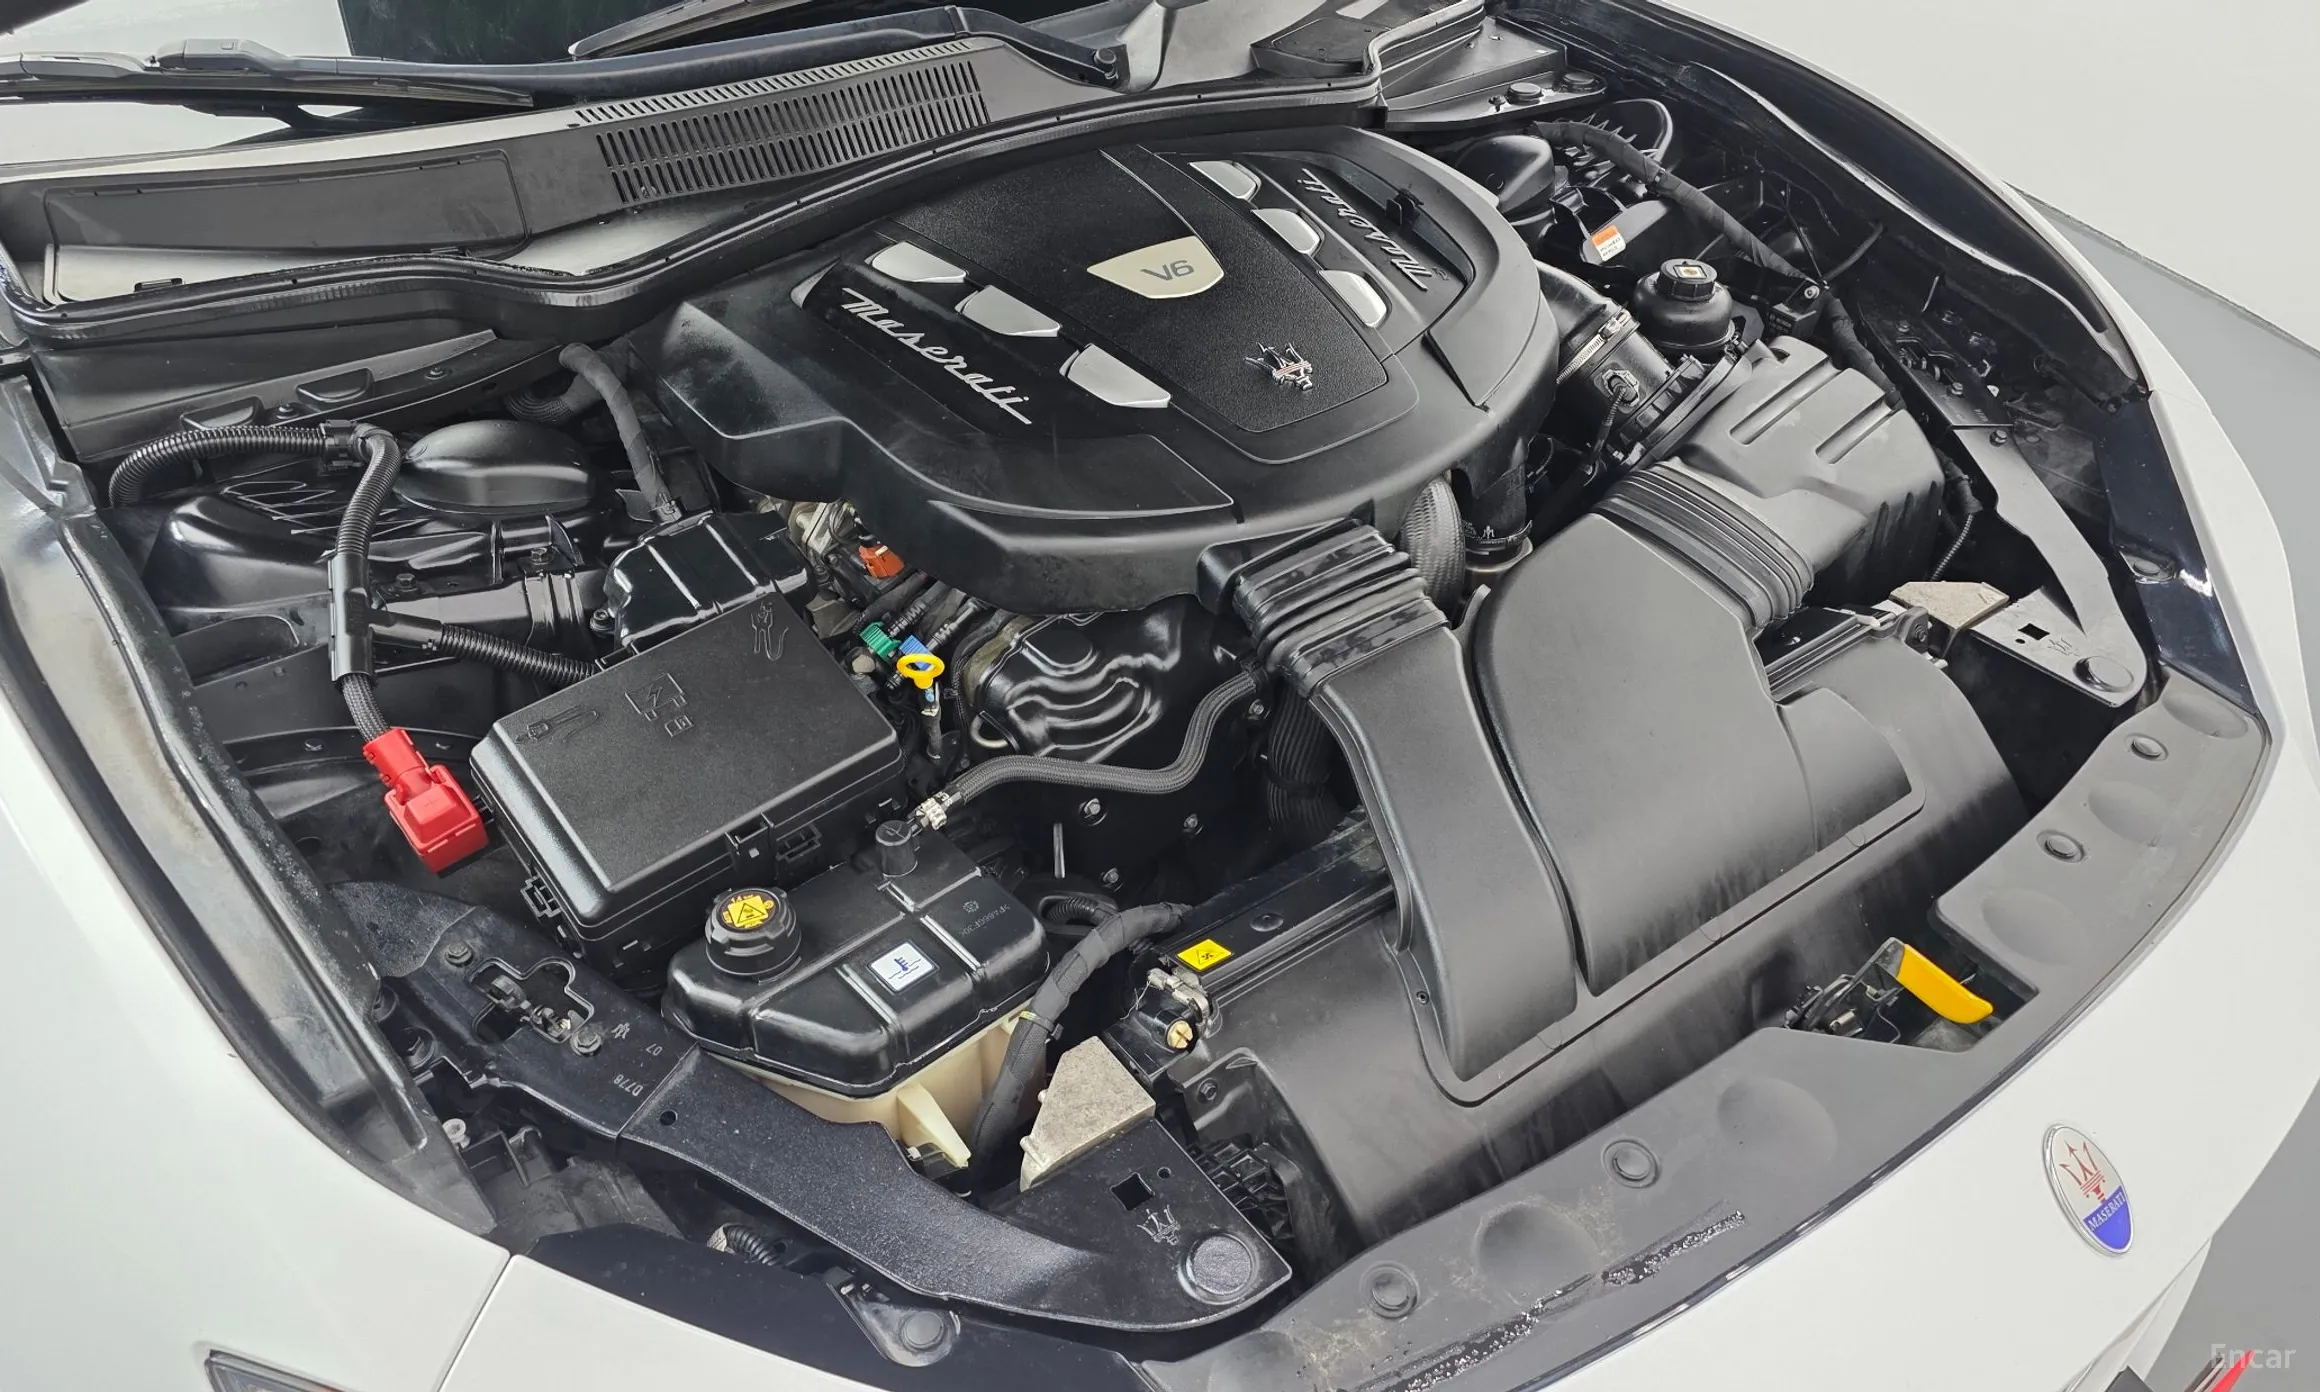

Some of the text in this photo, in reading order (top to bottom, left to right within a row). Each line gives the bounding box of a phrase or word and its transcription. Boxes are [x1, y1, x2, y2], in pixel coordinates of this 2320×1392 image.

[1297, 168, 1433, 291] Maserati
[1140, 260, 1194, 281] V6
[840, 287, 1033, 425] Maserati
[2087, 1191, 2126, 1231] MASERATI
